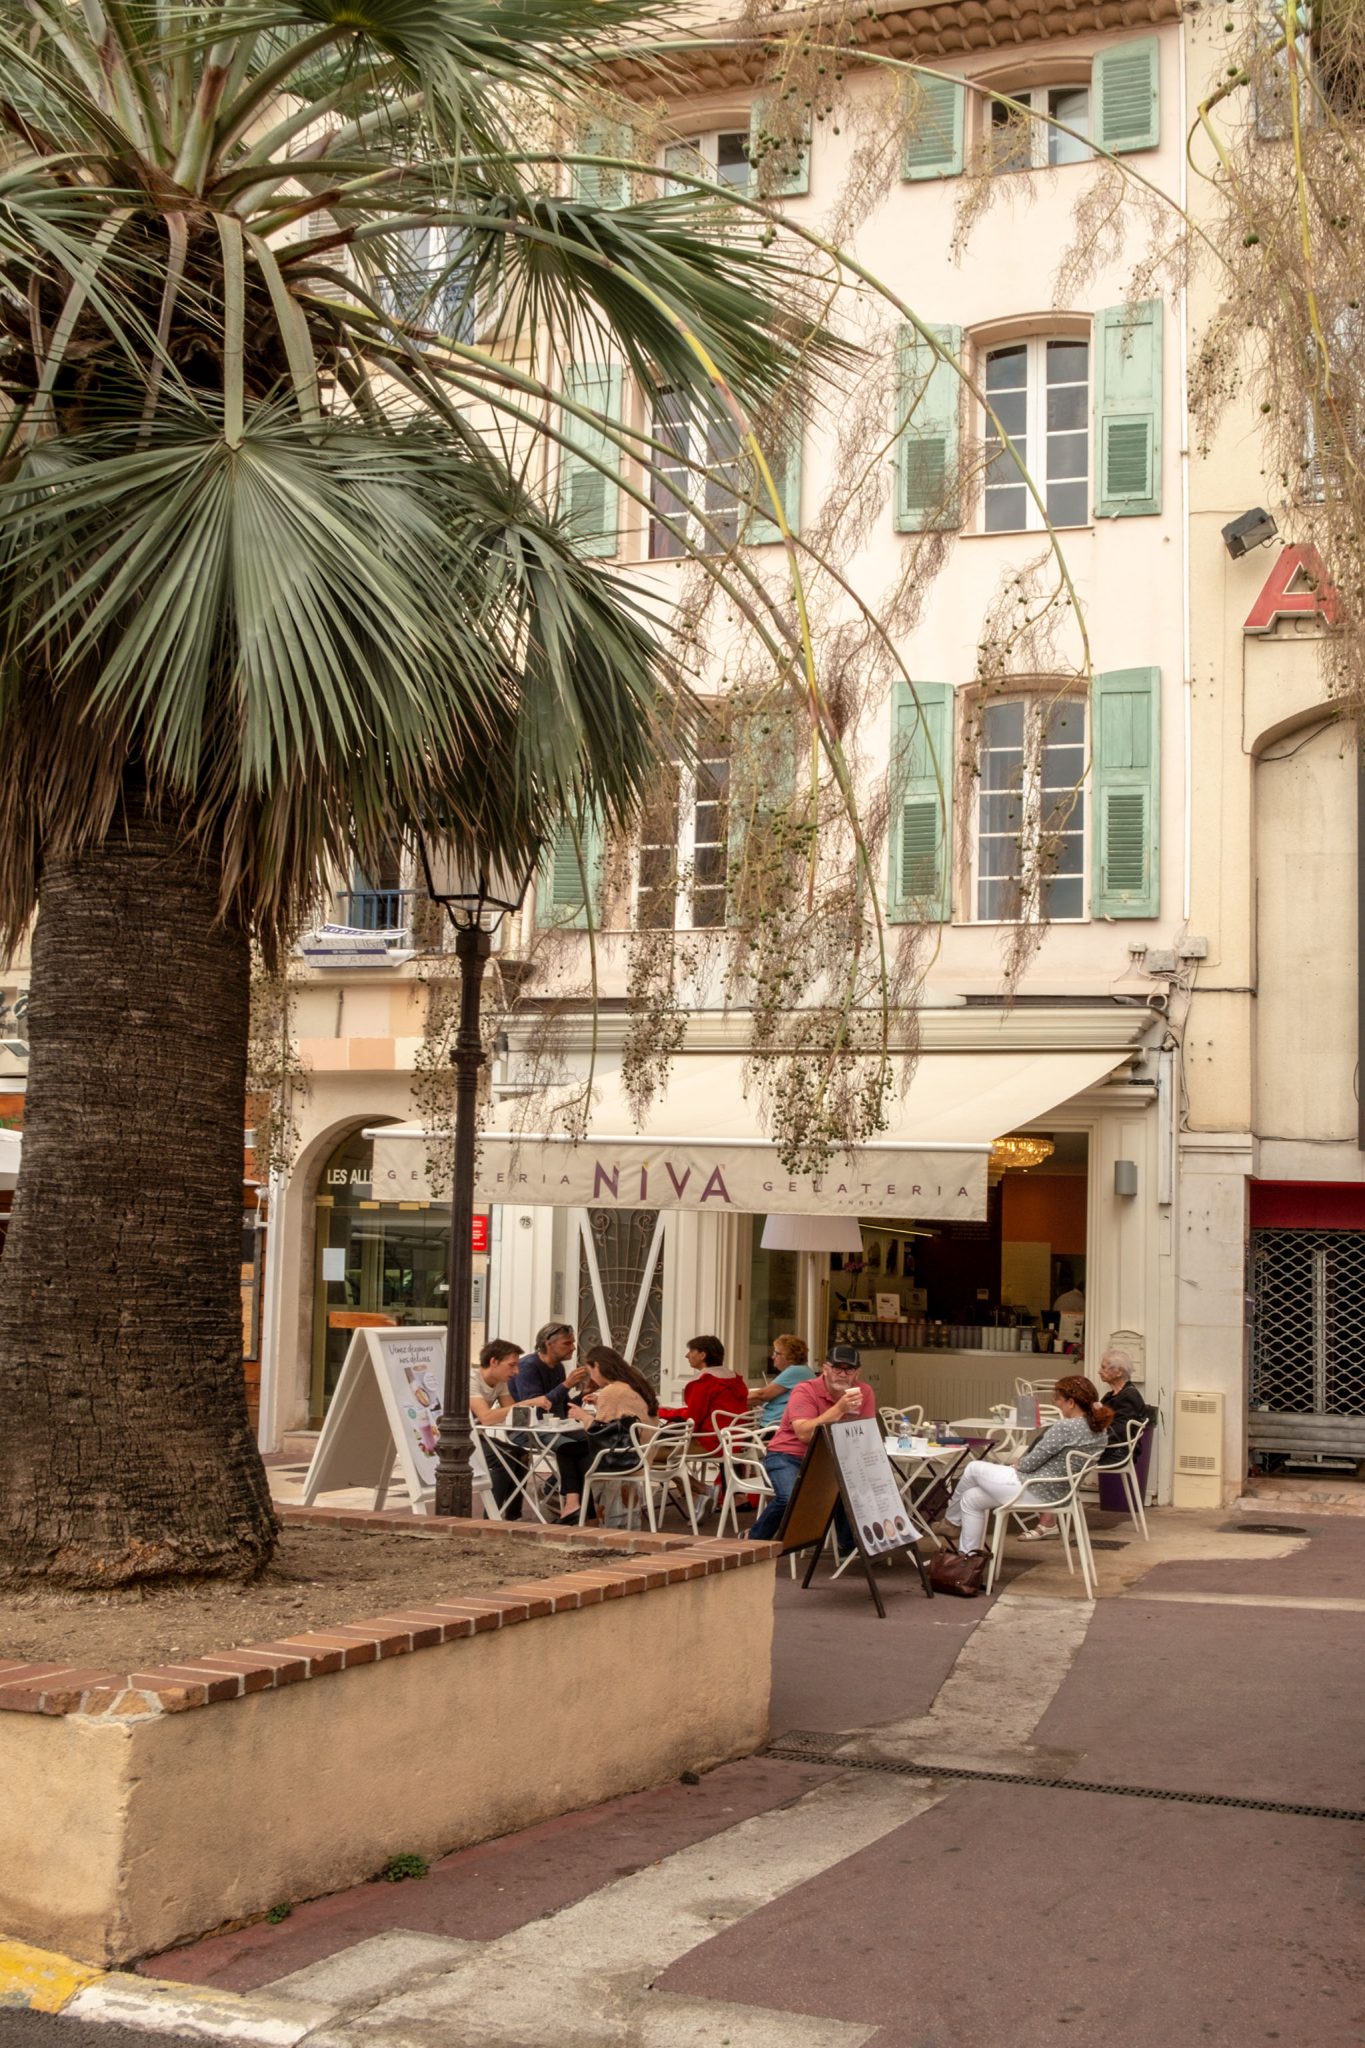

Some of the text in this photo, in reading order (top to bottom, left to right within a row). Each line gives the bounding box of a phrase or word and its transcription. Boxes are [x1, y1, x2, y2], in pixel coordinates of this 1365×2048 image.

[1243, 543, 1346, 630] A
[327, 1169, 348, 1185] LES
[593, 1159, 732, 1203] NIVA
[762, 1181, 968, 1197] GELATERIA
[845, 1425, 864, 1439] NIVA
